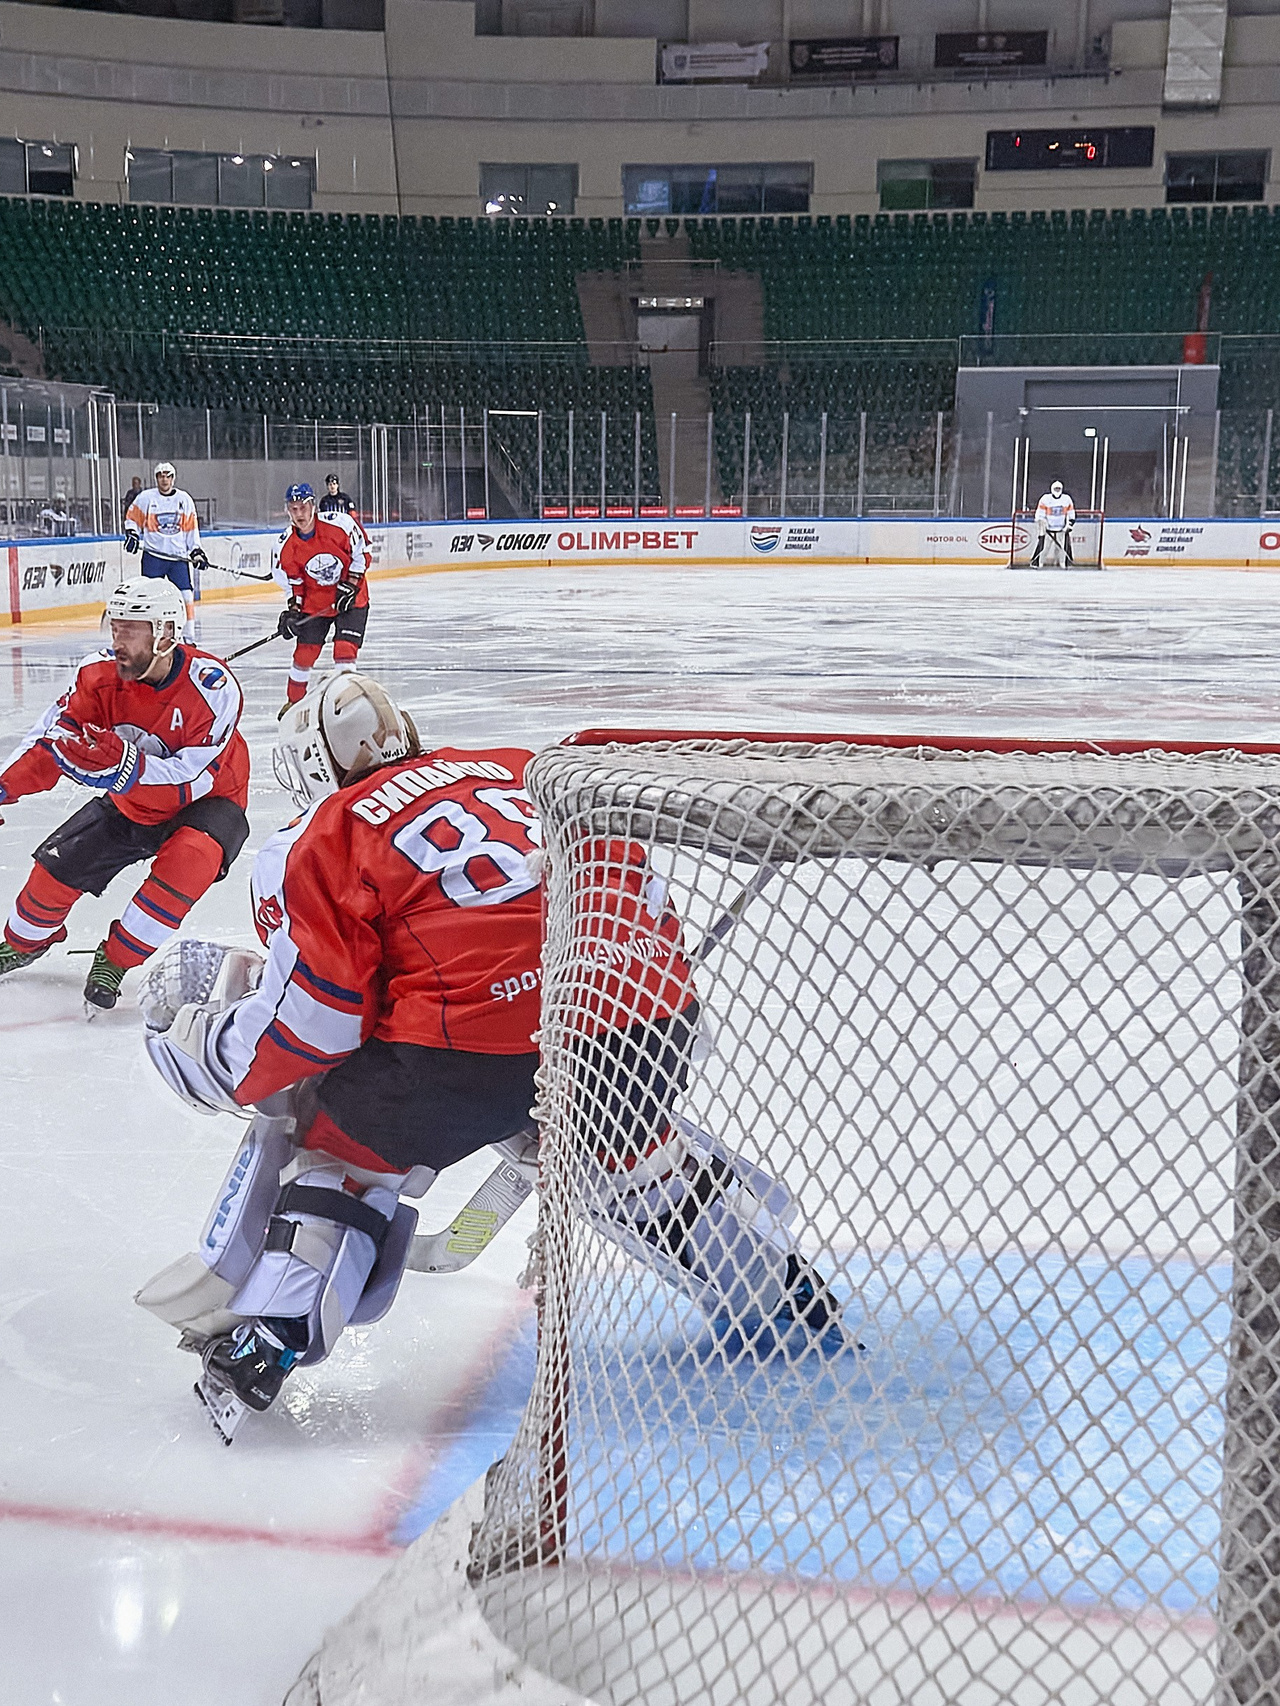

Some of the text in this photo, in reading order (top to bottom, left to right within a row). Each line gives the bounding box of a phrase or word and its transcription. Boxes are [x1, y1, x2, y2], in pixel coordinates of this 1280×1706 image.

[496, 533, 552, 551] СОКОЛ!
[557, 531, 699, 550] OLIMPBET
[981, 534, 1028, 544] SINTEC
[67, 561, 107, 586] СОКОЛ!
[169, 707, 184, 732] A
